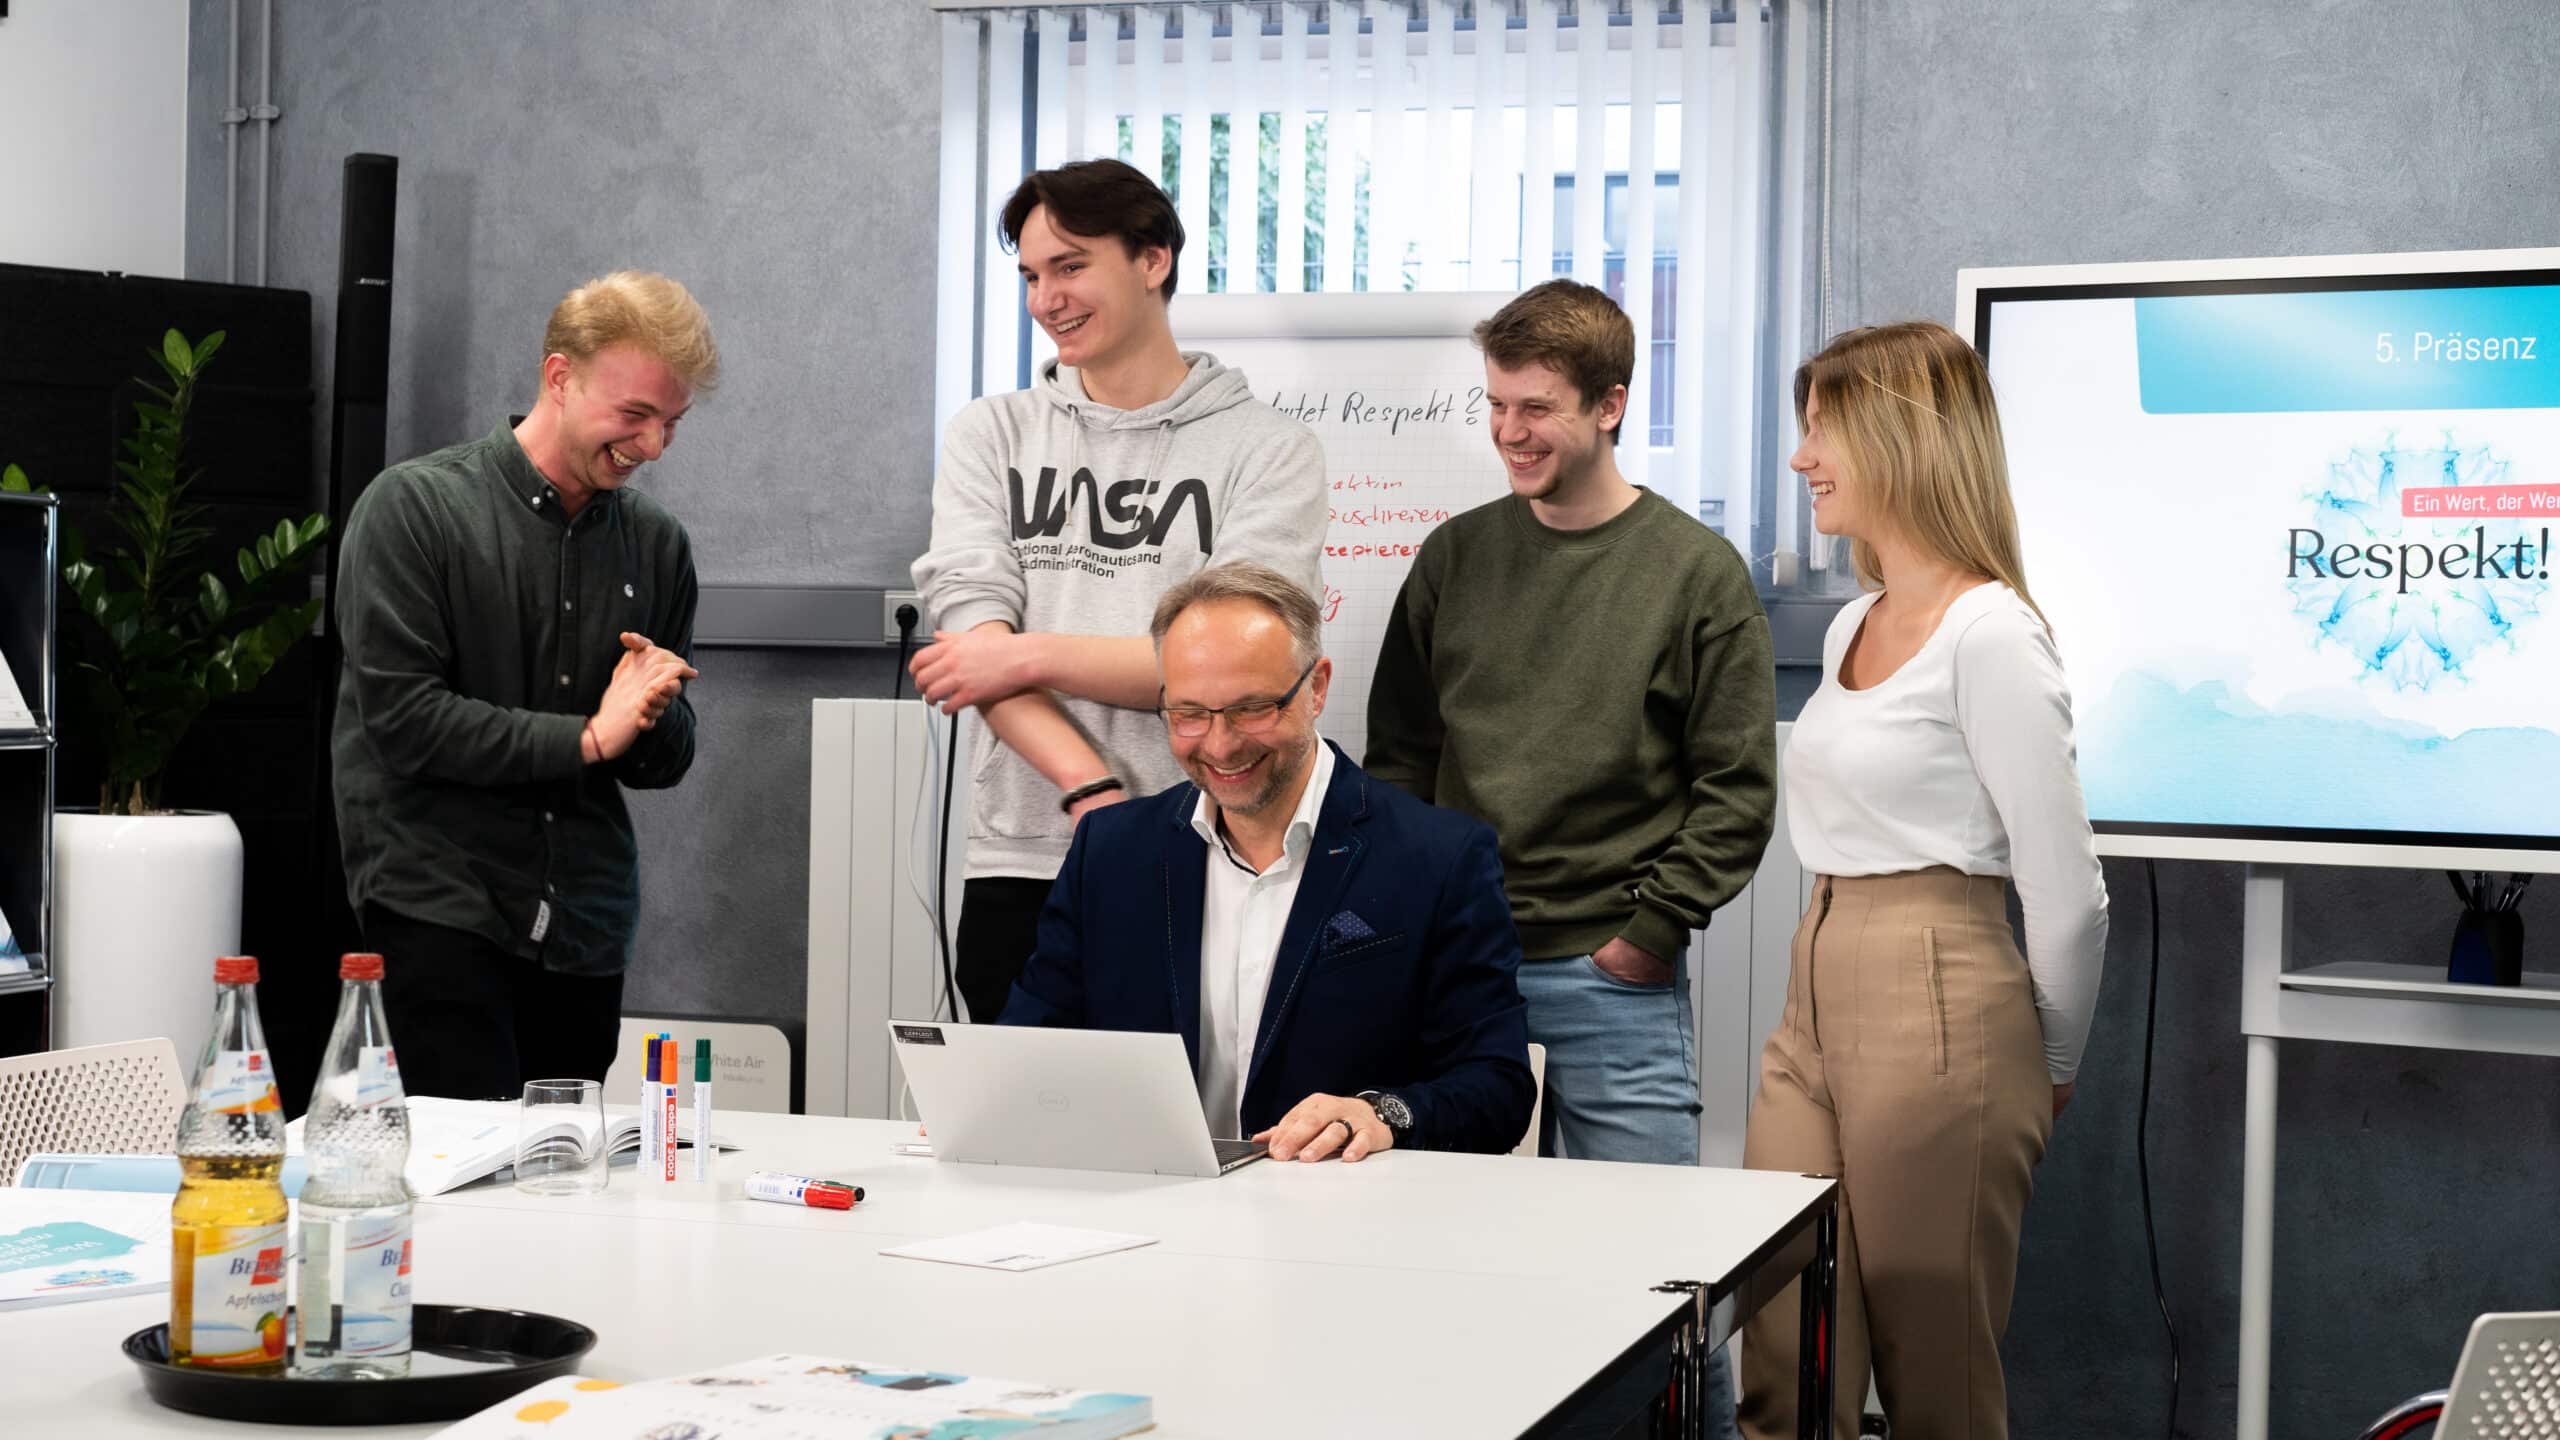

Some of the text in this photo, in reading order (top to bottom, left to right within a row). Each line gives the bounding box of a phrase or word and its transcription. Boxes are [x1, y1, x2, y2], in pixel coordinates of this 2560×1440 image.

[2376, 331, 2537, 362] 5. Präsenz
[1342, 388, 1455, 436] Respekt
[1008, 466, 1213, 556] NASA
[2413, 494, 2440, 512] Ein
[2445, 493, 2491, 513] Wert,
[2496, 492, 2524, 510] der
[1138, 551, 1162, 565] and
[2286, 525, 2550, 594] Respekt!
[744, 1055, 766, 1069] Air
[666, 1103, 676, 1177] edding 3000
